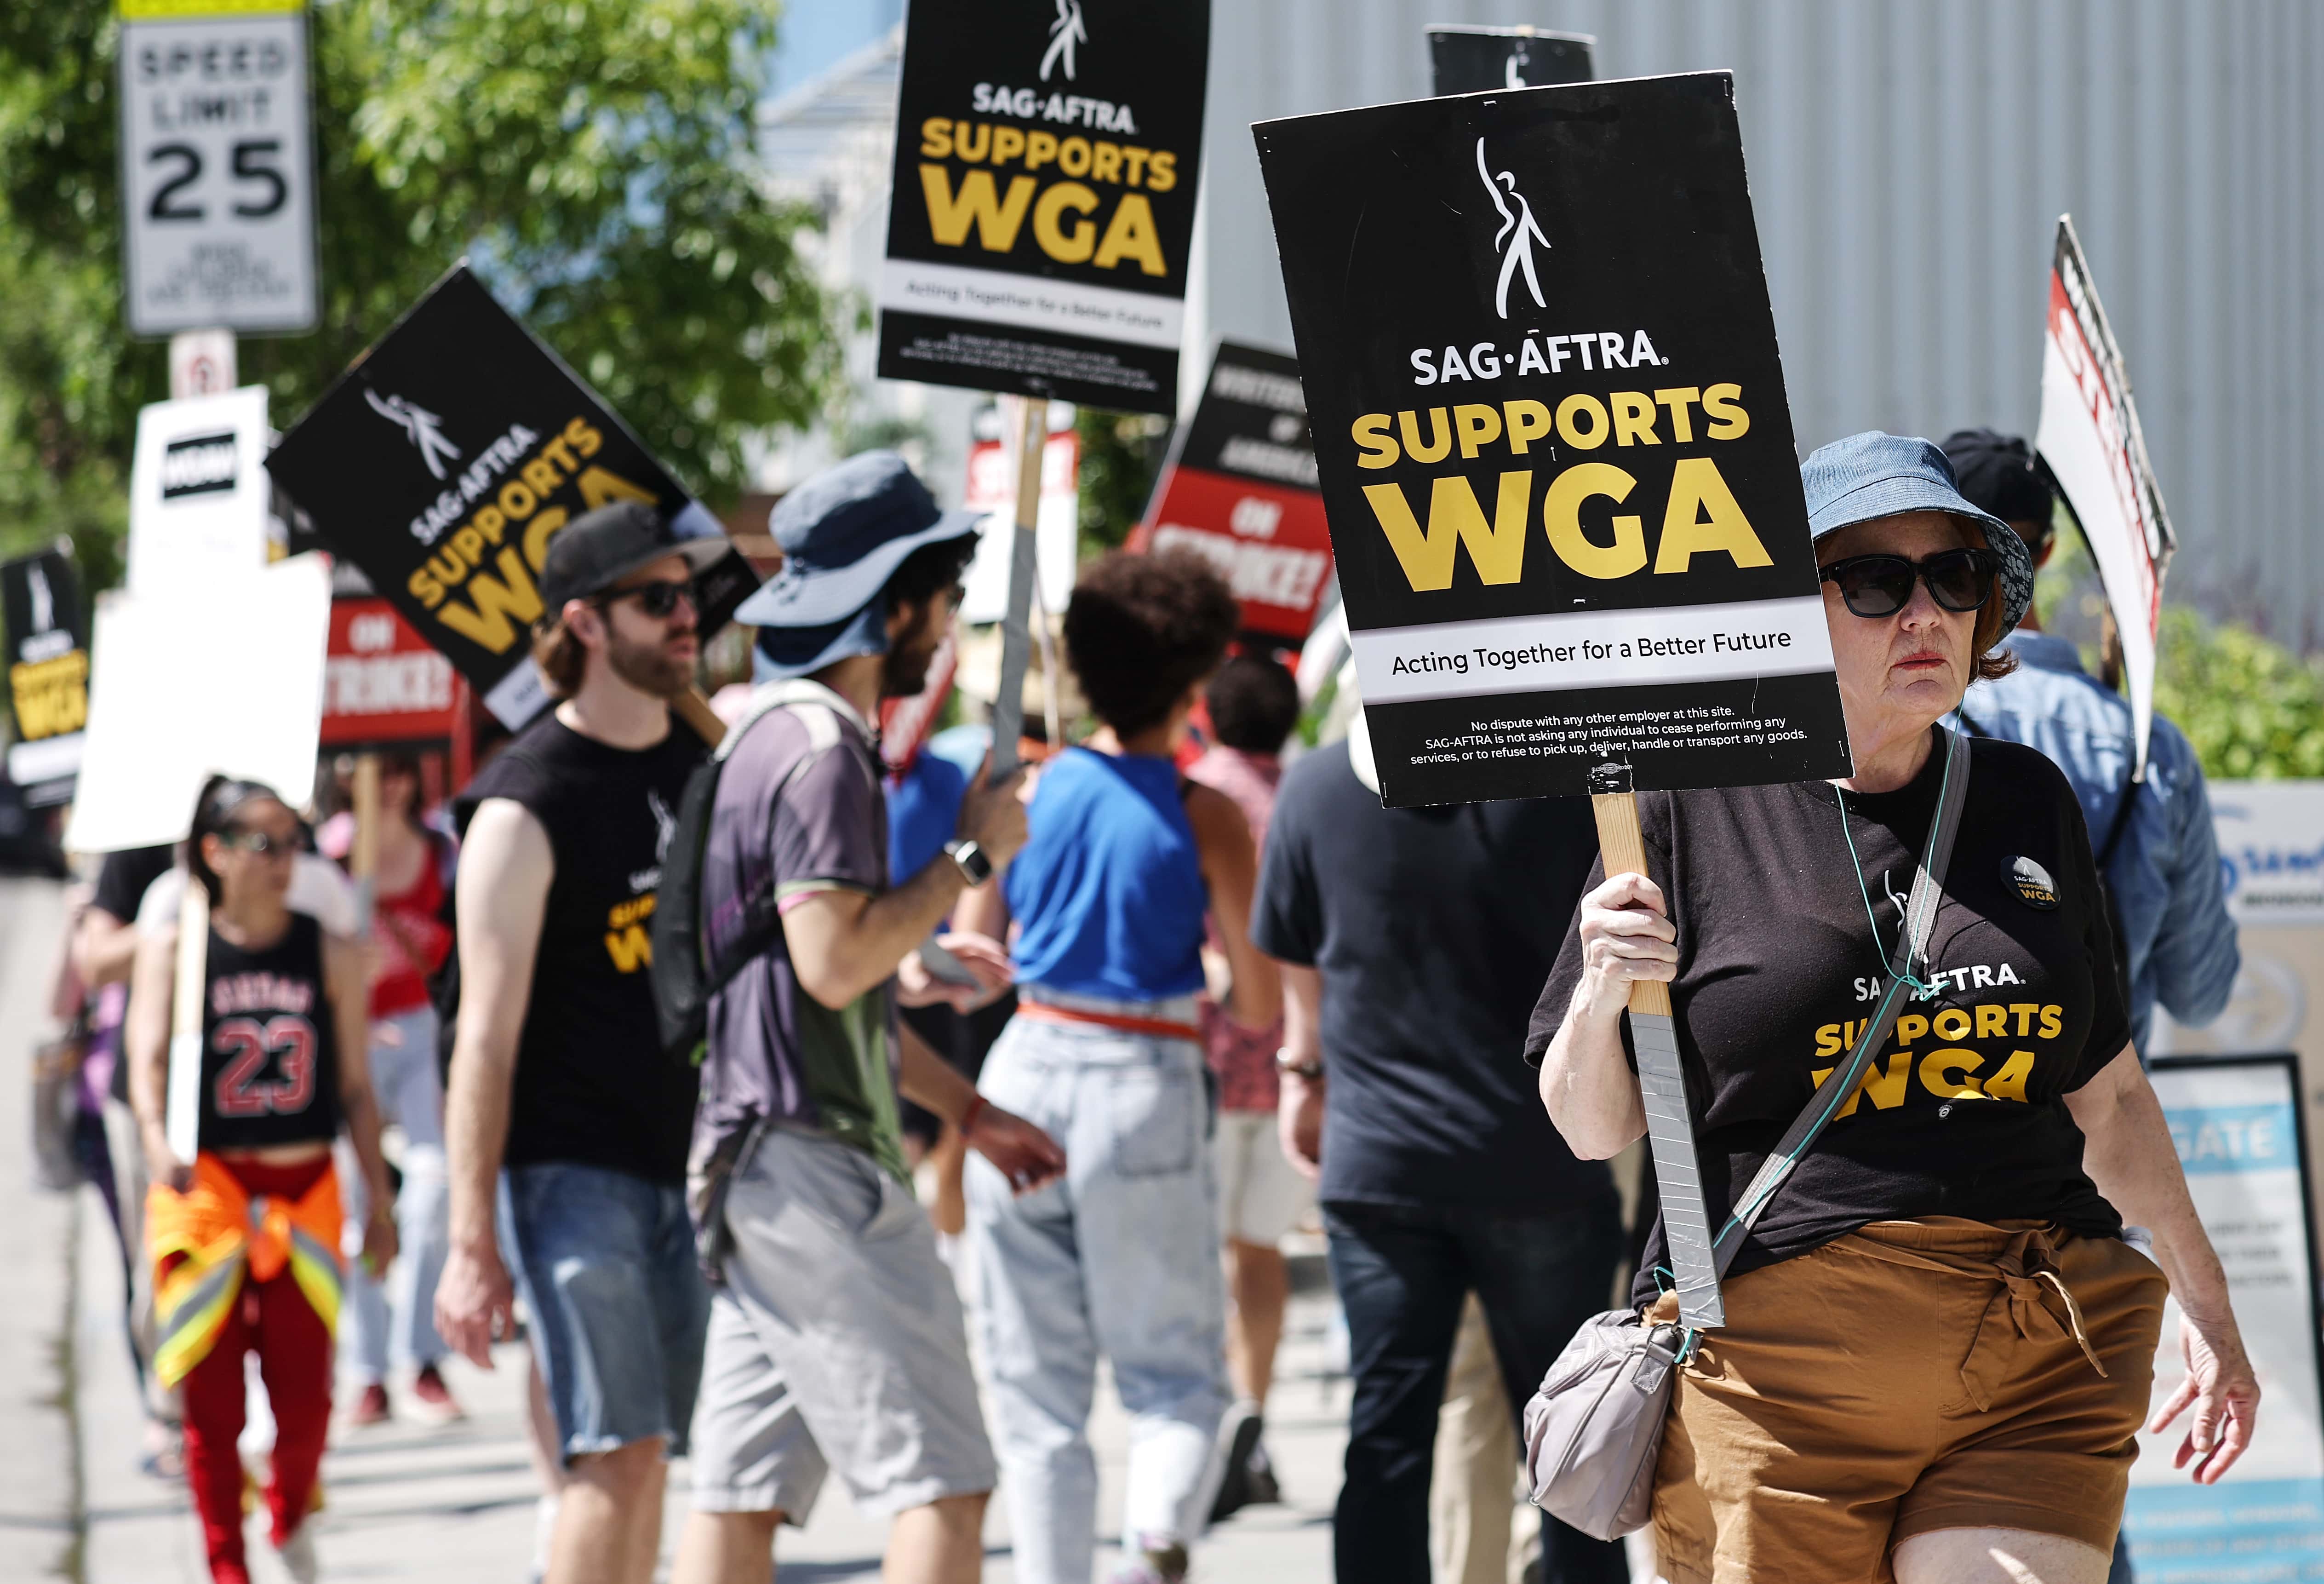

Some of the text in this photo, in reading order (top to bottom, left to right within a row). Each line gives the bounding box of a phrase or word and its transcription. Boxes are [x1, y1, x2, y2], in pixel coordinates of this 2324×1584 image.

[139, 40, 286, 82] SPEED
[153, 89, 269, 129] LIMIT
[147, 139, 288, 221] 25
[921, 117, 1177, 192] SUPPORTS
[920, 163, 1167, 277] WGA
[1351, 383, 1750, 469] SUPPORTS
[407, 415, 603, 611] SUPPORTS
[1362, 457, 1774, 592] WGA
[1392, 632, 1791, 675] Acting Together for a Better Future
[1410, 752, 1460, 764] services,
[1462, 752, 1473, 760] or
[1476, 750, 1488, 759] to
[1491, 747, 1526, 758] refuse
[1528, 746, 1541, 755] to
[1543, 743, 1568, 757] pick
[1569, 744, 1587, 757] up,
[1589, 740, 1630, 751] deliver,
[1631, 738, 1670, 750] handle
[1686, 735, 1741, 747] transport
[1743, 734, 1764, 745] any
[1768, 729, 1807, 744] goods.
[1425, 717, 1786, 749] SAG-AFTRA is not asking any individual to cease performing any
[1471, 706, 1735, 731] No dispute with any other employer at this site.
[2020, 889, 2056, 902] WGA
[1815, 1003, 2063, 1057] SUPORTS
[212, 1016, 317, 1118] 23
[1811, 1048, 2035, 1122] WGA
